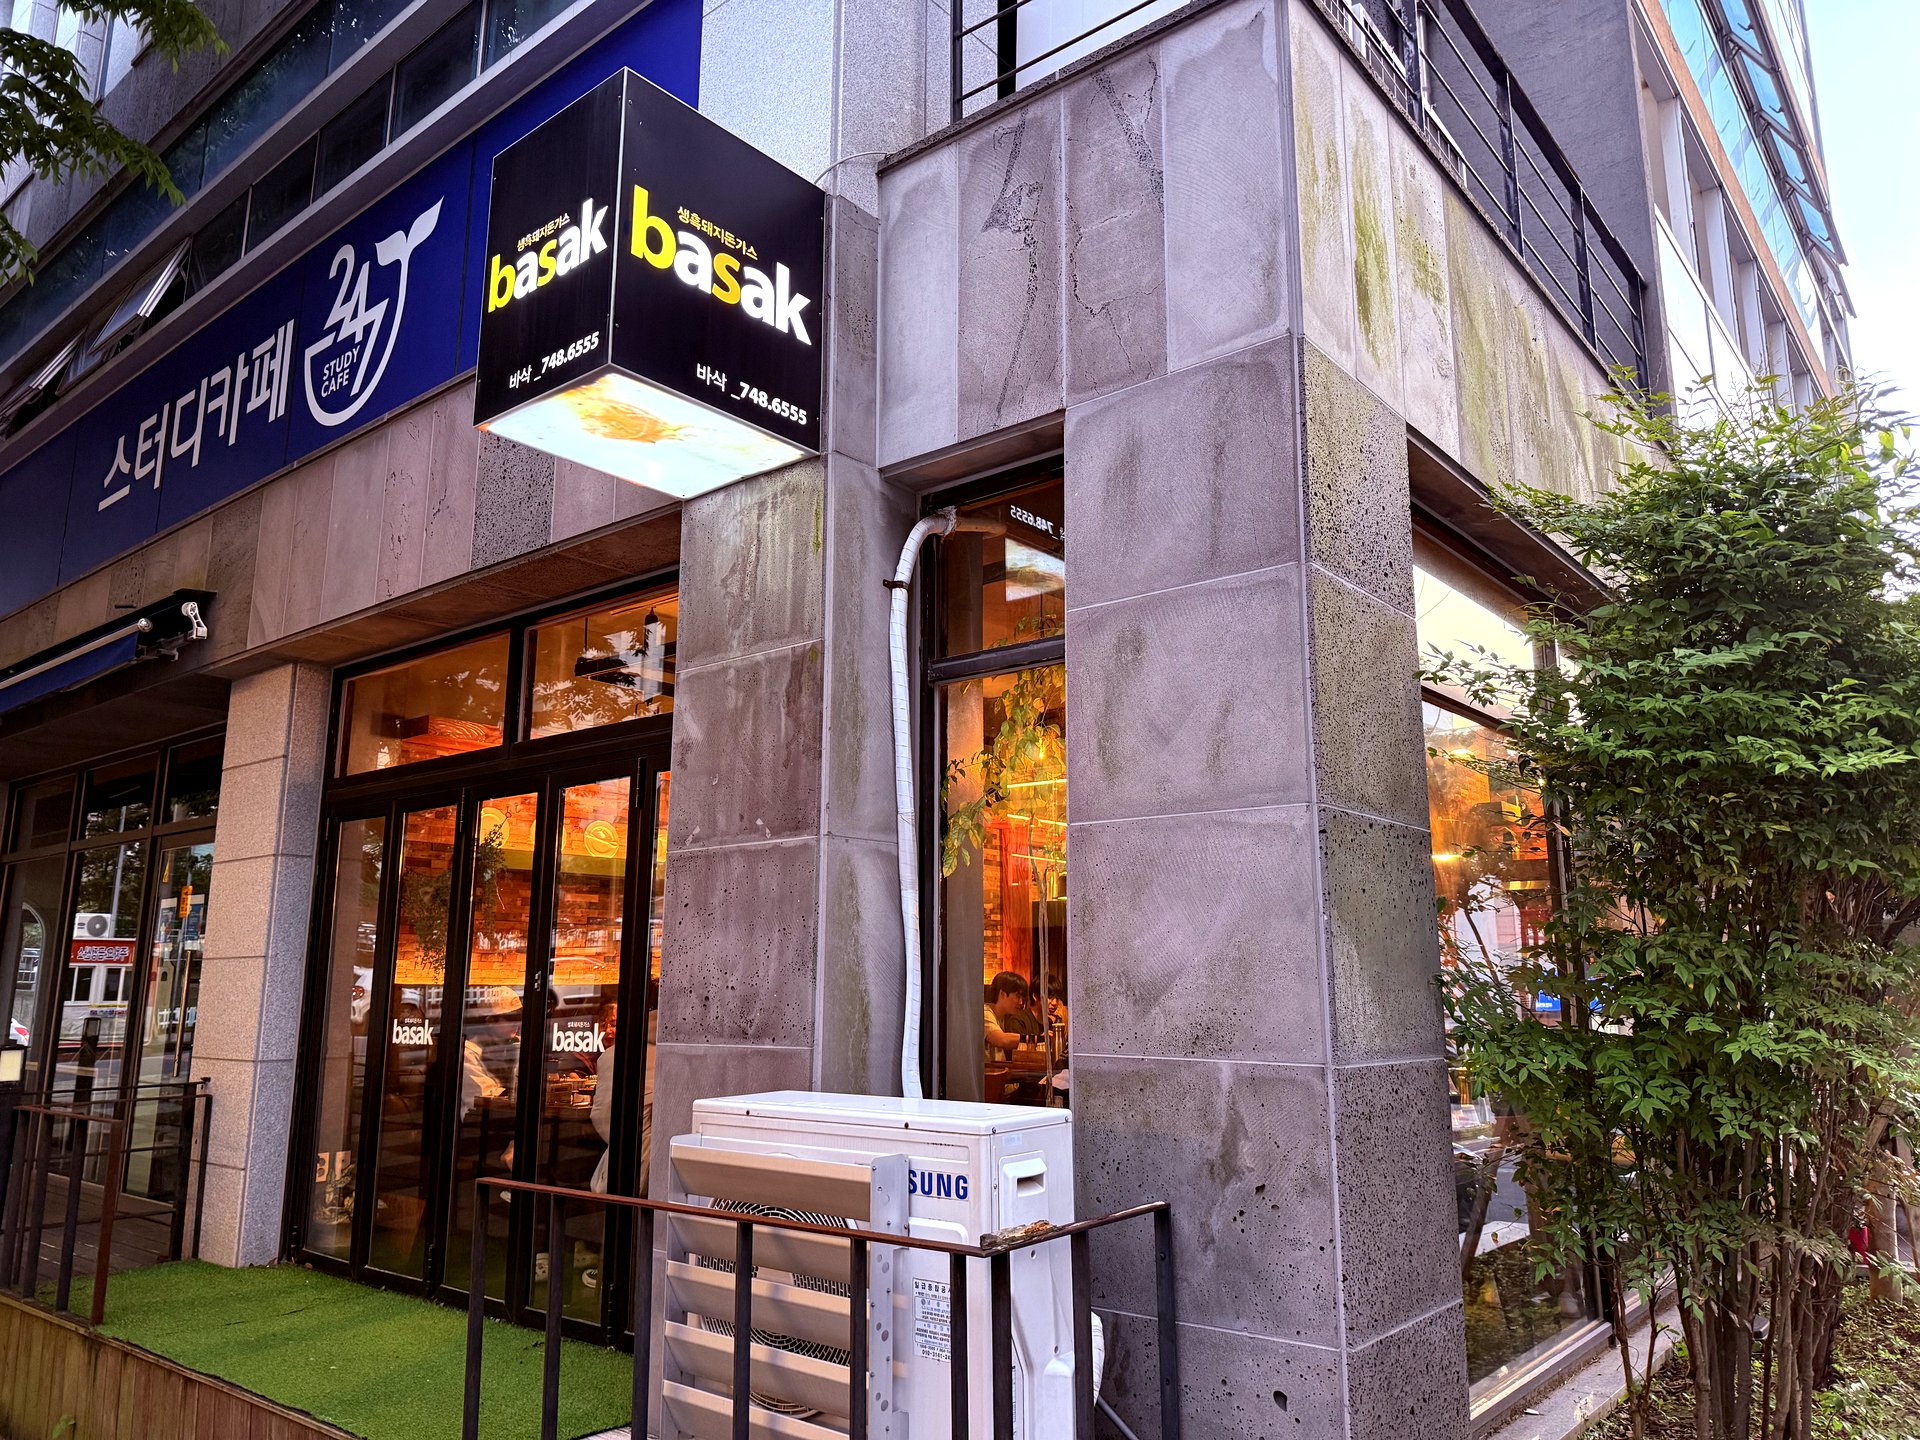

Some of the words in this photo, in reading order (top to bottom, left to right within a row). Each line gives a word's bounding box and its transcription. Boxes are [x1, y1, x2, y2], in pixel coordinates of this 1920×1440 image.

[677, 206, 758, 261] 생흑돼지돈가스
[487, 197, 609, 313] basak
[630, 184, 812, 345] basak
[323, 345, 361, 380] STUDY
[508, 363, 533, 390] 바삭
[695, 362, 728, 393] 바삭
[320, 369, 350, 398] CAFE
[97, 319, 295, 511] 스터디카페
[392, 1018, 434, 1046] basak
[552, 1022, 606, 1053] basak
[909, 1169, 968, 1200] SUNG
